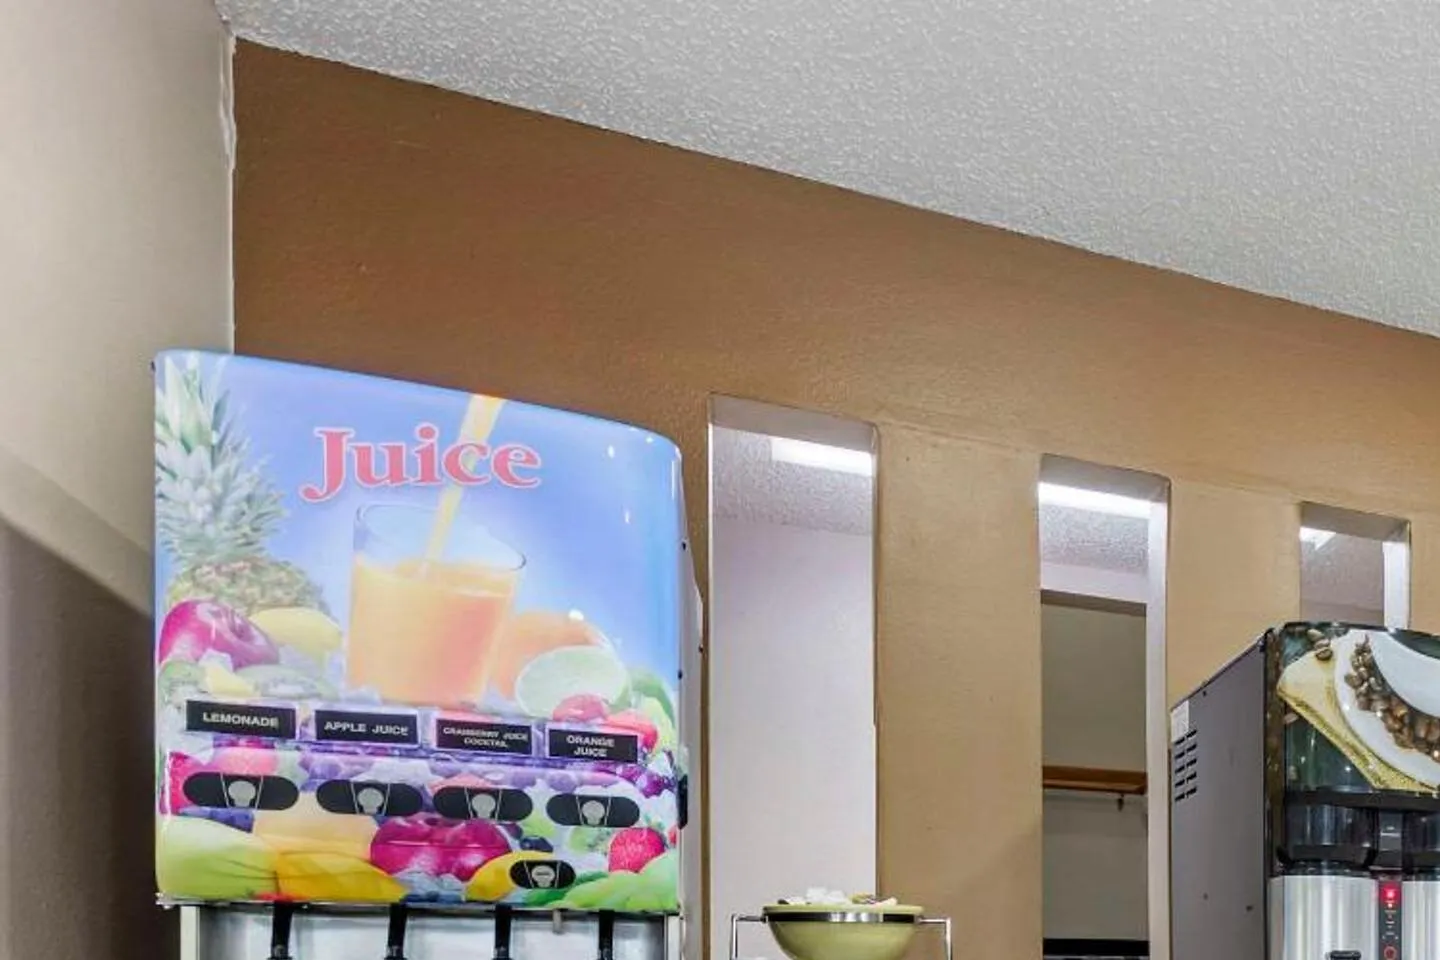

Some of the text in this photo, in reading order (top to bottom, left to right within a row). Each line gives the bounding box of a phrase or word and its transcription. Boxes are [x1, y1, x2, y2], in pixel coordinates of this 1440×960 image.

[300, 424, 541, 501] Juice
[203, 711, 279, 728] LEMONADE
[323, 721, 409, 736] APPLE JUICE
[566, 735, 614, 748] ORANGE
[573, 746, 608, 758] JUICE
